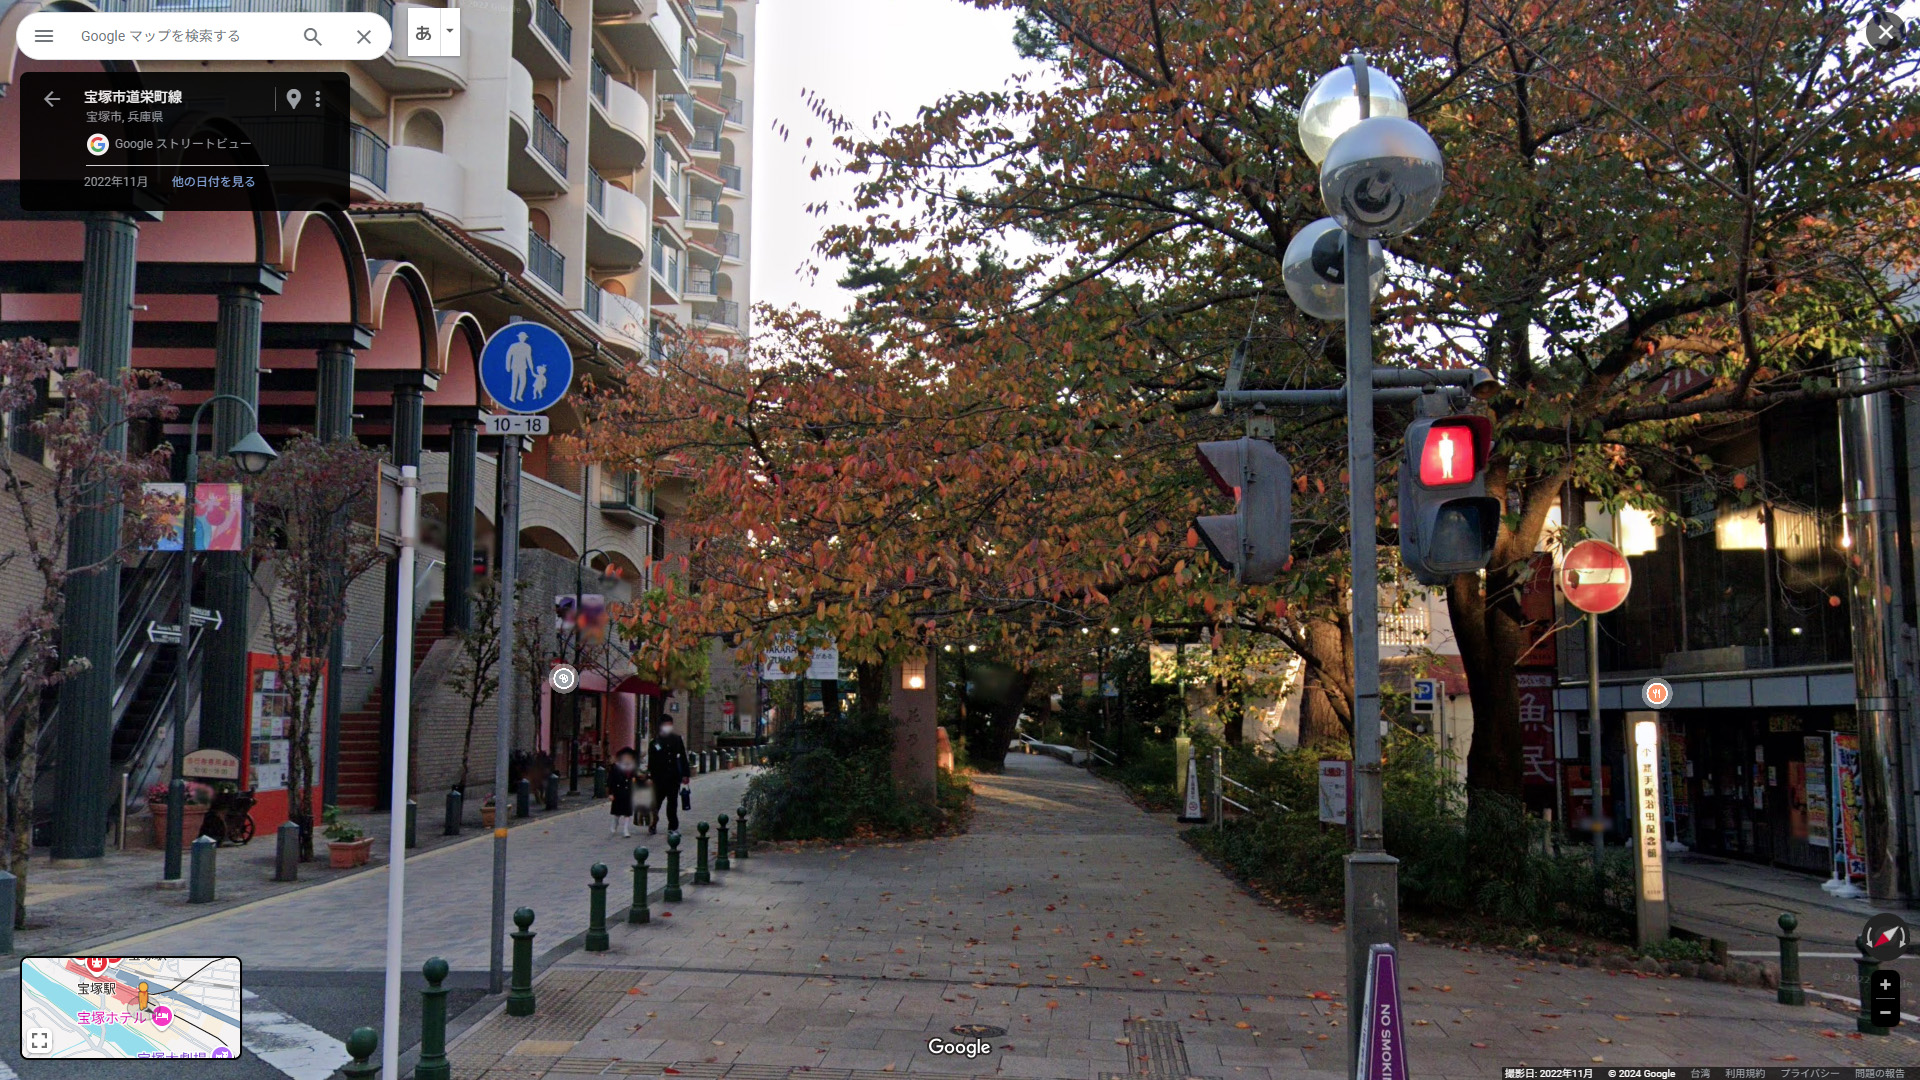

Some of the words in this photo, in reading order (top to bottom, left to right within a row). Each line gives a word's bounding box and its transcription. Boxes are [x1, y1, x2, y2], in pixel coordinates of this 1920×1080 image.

[1519, 692, 1555, 783] 魚民
[1380, 1003, 1391, 1027] NO
[1381, 1029, 1393, 1080] SMOKI
